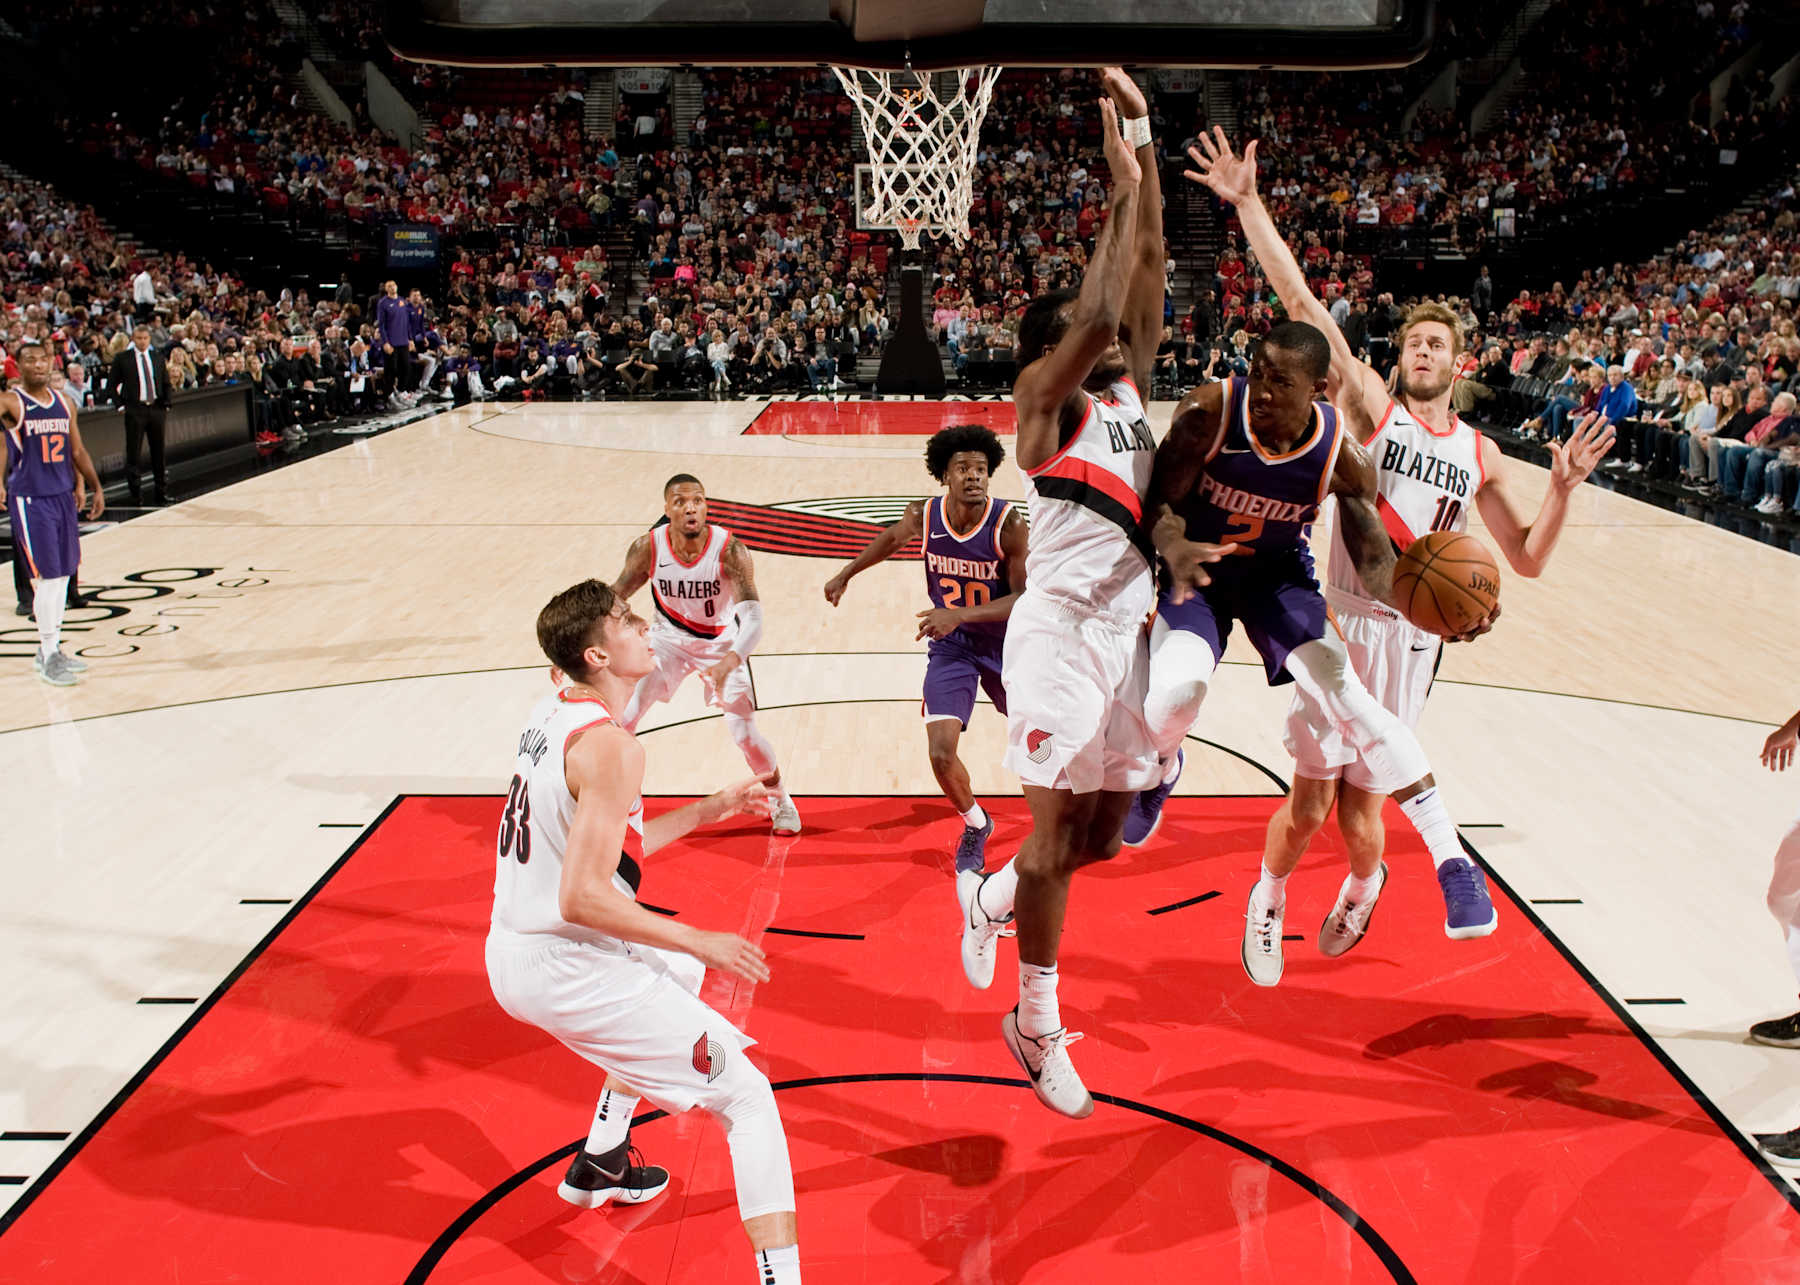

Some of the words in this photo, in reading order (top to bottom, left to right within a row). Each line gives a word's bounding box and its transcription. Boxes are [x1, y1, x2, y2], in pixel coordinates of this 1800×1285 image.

[41, 434, 65, 463] 12
[1381, 438, 1470, 497] BLAZERS
[1198, 472, 1313, 522] PHOENIX
[1429, 494, 1462, 532] 10
[1219, 512, 1265, 557] 2
[927, 551, 1000, 580] PHOENIX
[658, 579, 720, 599] BLAZERS
[939, 577, 991, 609] 20
[704, 599, 716, 618] 0
[500, 774, 531, 864] 33
